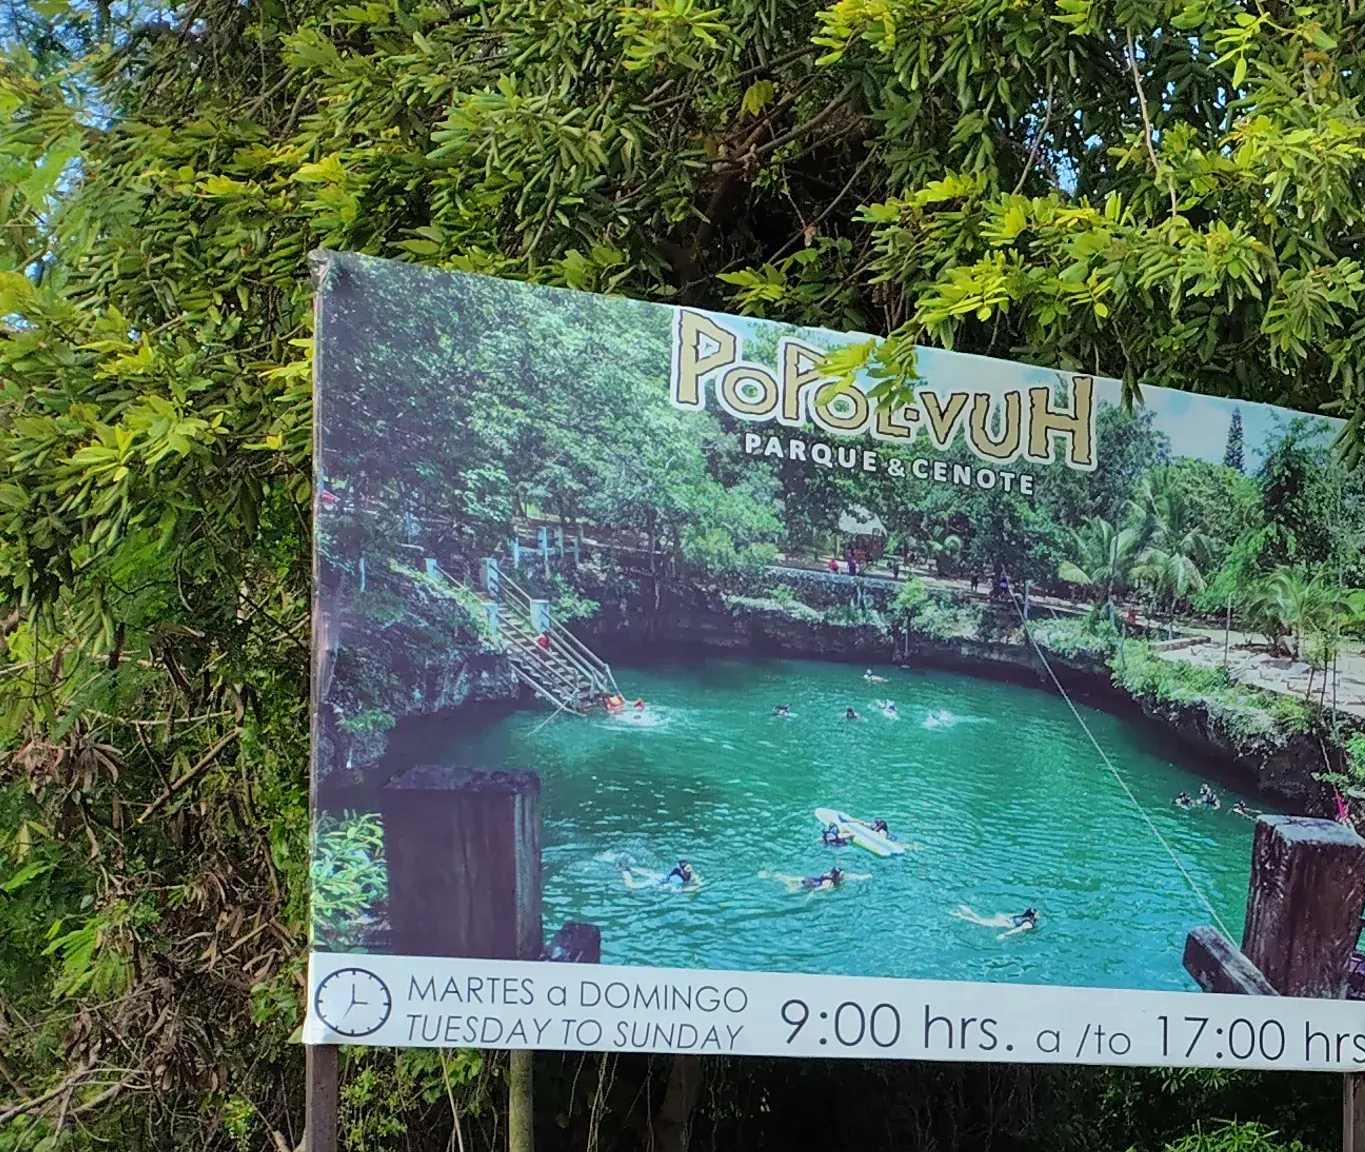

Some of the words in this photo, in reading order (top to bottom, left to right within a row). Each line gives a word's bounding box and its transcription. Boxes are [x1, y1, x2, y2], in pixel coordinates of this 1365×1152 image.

[745, 432, 877, 472] PARQUE
[888, 458, 906, 477] &
[913, 459, 1034, 496] CENOTE
[409, 975, 535, 1005] MARTES
[547, 984, 568, 1005] a
[580, 981, 749, 1014] DOMINGO
[406, 1013, 552, 1045] TUESDAY
[562, 1019, 604, 1046] TO
[613, 1020, 744, 1051] SUNDAY
[780, 998, 902, 1047] 9:00
[924, 1004, 1015, 1052] hrs.
[1158, 1015, 1286, 1061] 17:00
